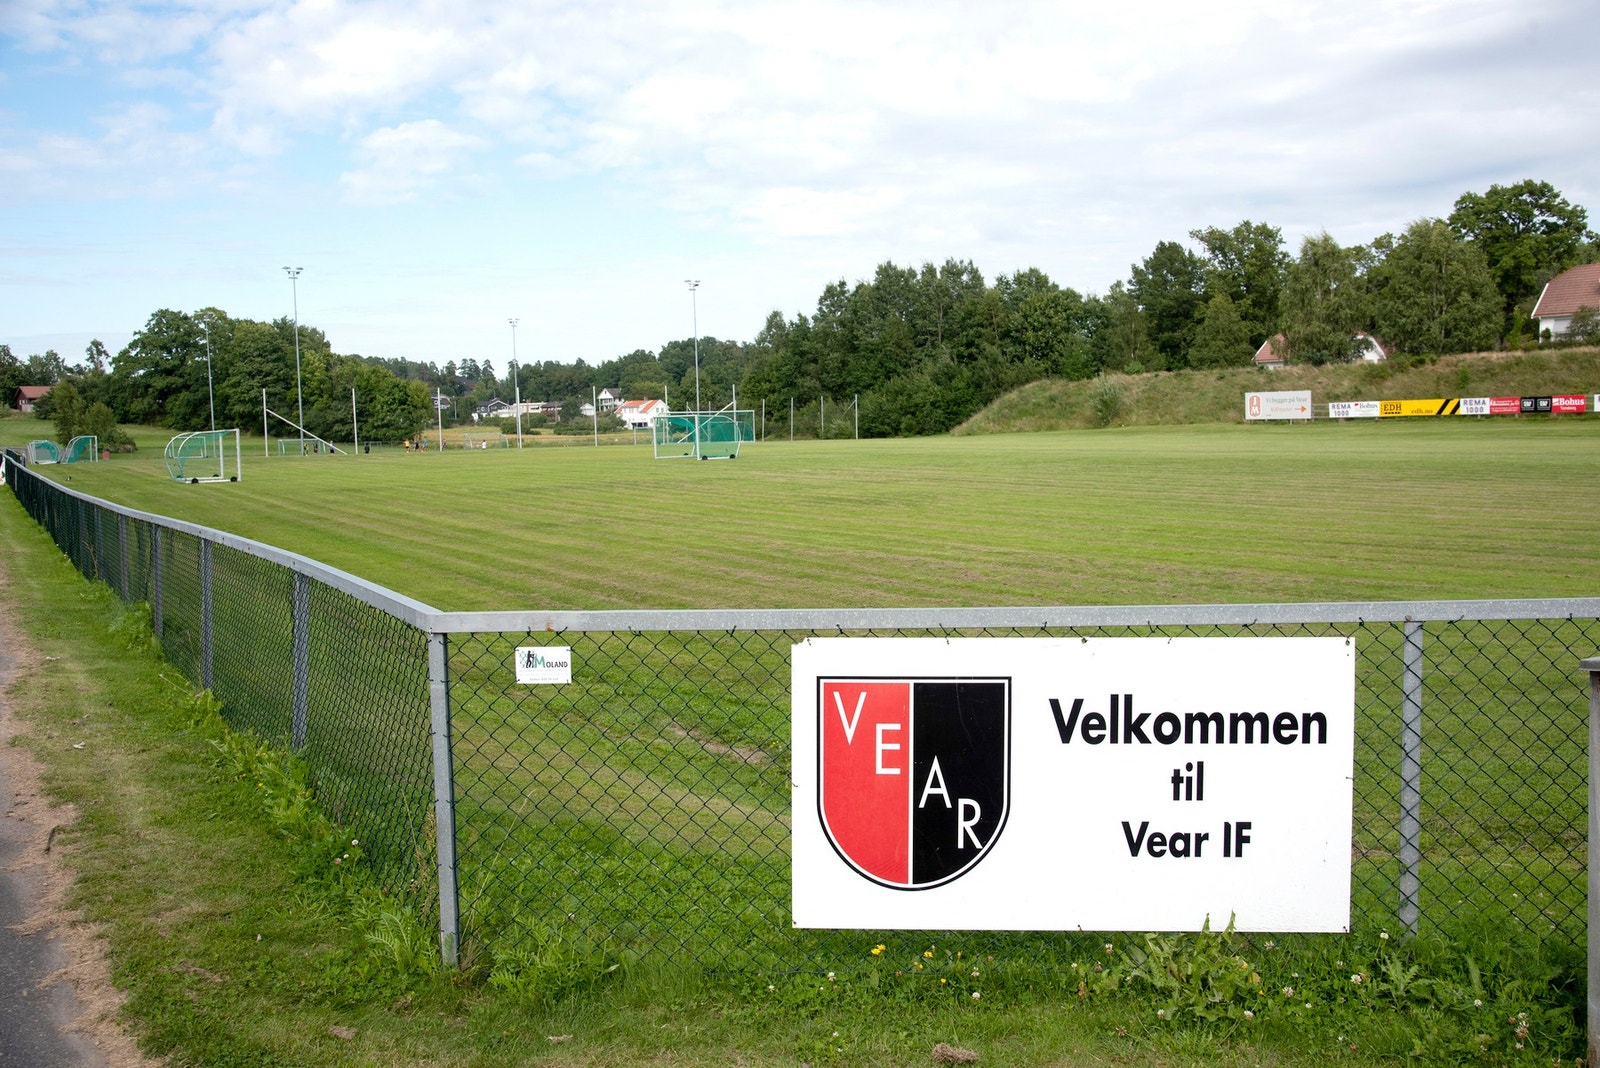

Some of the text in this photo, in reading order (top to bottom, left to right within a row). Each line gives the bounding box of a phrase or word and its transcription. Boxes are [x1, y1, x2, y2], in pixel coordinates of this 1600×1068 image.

[1559, 397, 1585, 406] Bohus
[534, 656, 568, 668] MOLAND
[1049, 694, 1327, 745] Velkommen
[833, 691, 984, 849] VEAR
[1171, 761, 1204, 801] til
[1121, 821, 1252, 858] Vear IF
